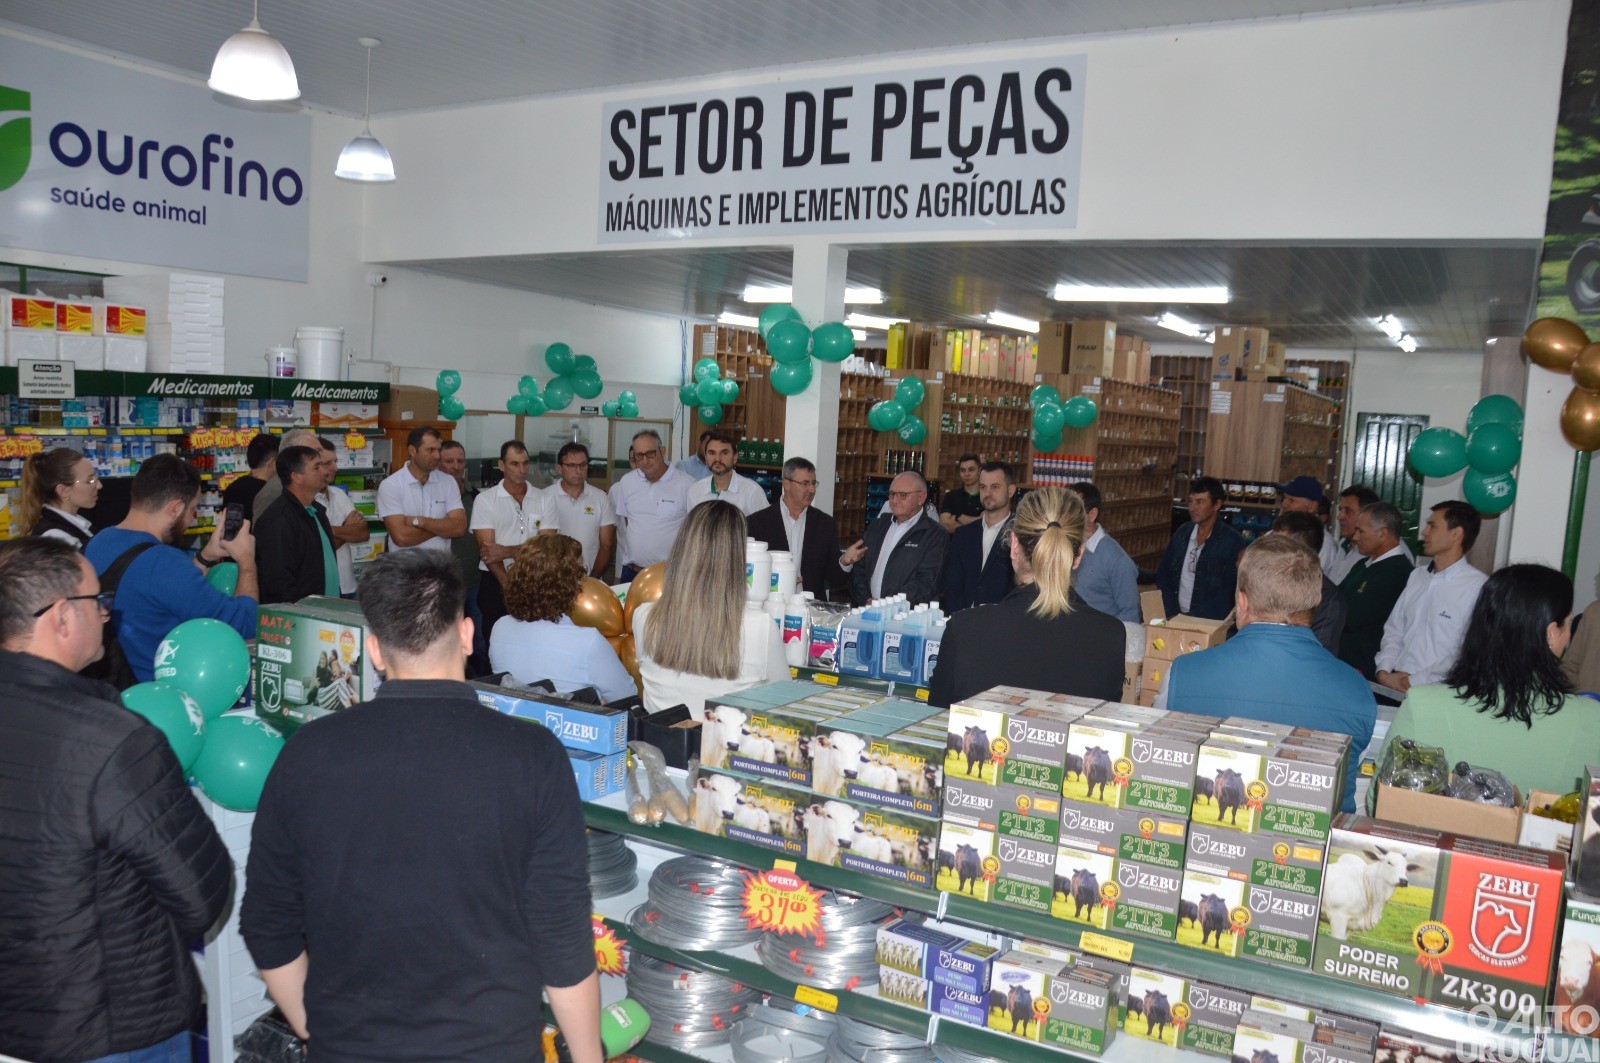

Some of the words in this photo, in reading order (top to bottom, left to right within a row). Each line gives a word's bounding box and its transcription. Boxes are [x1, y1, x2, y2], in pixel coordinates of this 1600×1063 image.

[608, 96, 764, 182] SETOR
[782, 86, 854, 168] DE
[870, 67, 1072, 174] PEÇAS
[50, 122, 303, 205] ourofino
[51, 186, 126, 213] saúde
[133, 199, 207, 225] animal
[605, 193, 712, 233] MÁQUINAS
[718, 194, 732, 226] E
[737, 184, 908, 225] IMPLEMENTOS
[915, 173, 1067, 218] AGRÍCOLAS
[147, 377, 254, 396] Medicamentos
[291, 382, 379, 400] Medicamentos
[261, 614, 291, 630] MATA
[261, 661, 282, 673] ZEBU
[563, 721, 599, 740] ZEBU
[1026, 727, 1066, 745] ZEBU
[1152, 747, 1195, 765] ZEBU
[734, 760, 760, 771] PORTEIRA
[760, 766, 789, 777] COMPLETA
[1006, 760, 1051, 782] 2TT3
[1288, 770, 1335, 789] ZEBU
[851, 789, 881, 800] PORTEIRA
[881, 796, 913, 807] COMPLETA
[962, 793, 994, 809] ZEBU
[1130, 781, 1178, 803] 2TT3
[1001, 812, 1046, 834] 2TT3
[1080, 816, 1115, 832] ZEBU
[1264, 805, 1316, 828] 2TT3
[729, 829, 756, 840] PORTEIRA
[756, 836, 785, 848] COMPLETA
[1122, 835, 1170, 858] 2TT3
[1209, 840, 1247, 857] ZEBU
[1017, 847, 1055, 865] ZEBU
[845, 858, 875, 870] PORTEIRA
[875, 865, 907, 878] COMPLETA
[1255, 861, 1306, 884] 2TT3
[768, 874, 798, 887] OFERTA
[997, 878, 1040, 900] 2TT3
[1138, 872, 1181, 891] ZEBU
[1478, 872, 1540, 899] ZEBU
[1117, 905, 1163, 928] 2TT3
[1271, 897, 1316, 917] ZEBU
[1571, 909, 1600, 923] Funçã
[1247, 930, 1297, 954] 2TT3
[1339, 944, 1399, 970] PODER
[1468, 943, 1490, 963] CERCAS
[951, 957, 976, 973] ZEBU
[1324, 959, 1410, 991] SUPREMO
[957, 989, 982, 1004] ZEBU
[1068, 989, 1106, 1008] ZEBU
[1441, 973, 1536, 1015] ZK300
[1048, 1019, 1092, 1042] 2TT3
[1187, 1024, 1232, 1047] 2TT3
